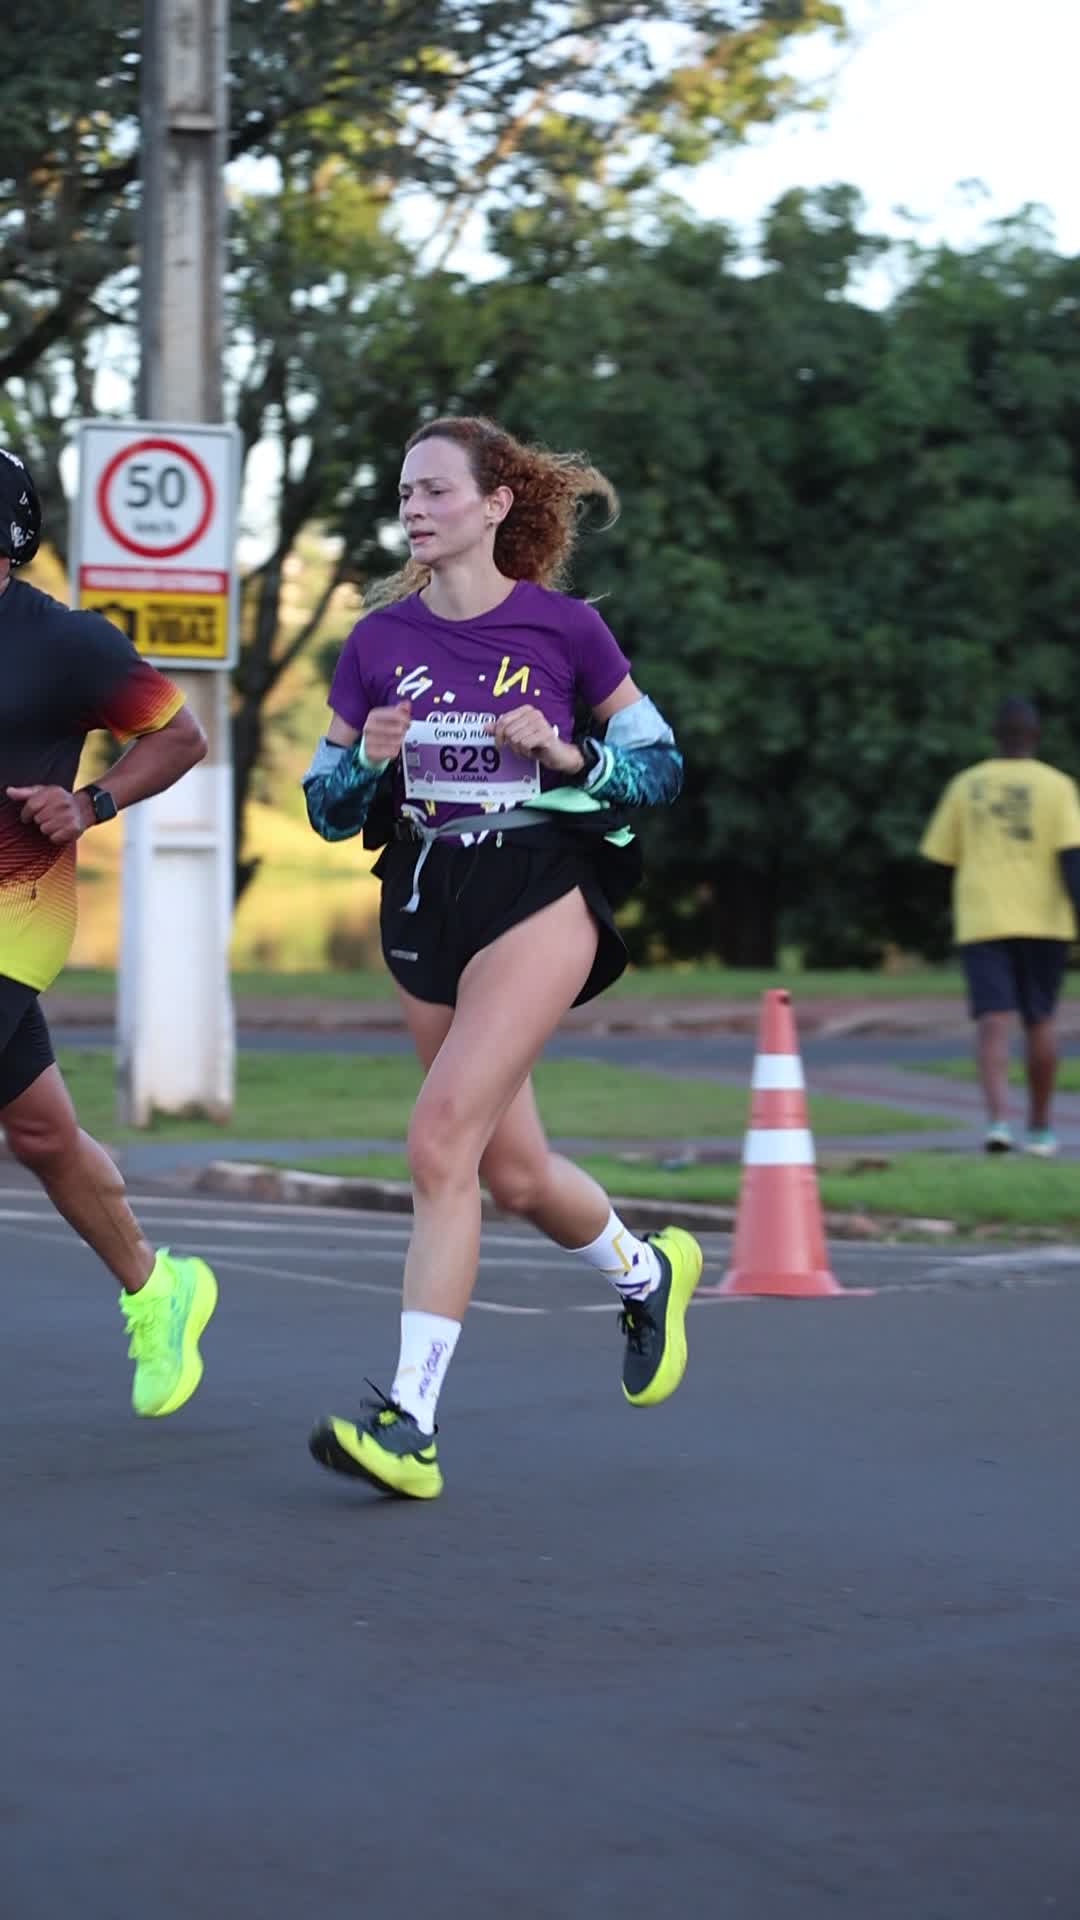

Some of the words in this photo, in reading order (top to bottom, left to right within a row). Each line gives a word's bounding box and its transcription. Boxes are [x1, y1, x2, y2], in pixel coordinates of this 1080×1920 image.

[127, 465, 186, 508] 50
[439, 745, 500, 773] 629
[452, 774, 489, 784] LUCIANA
